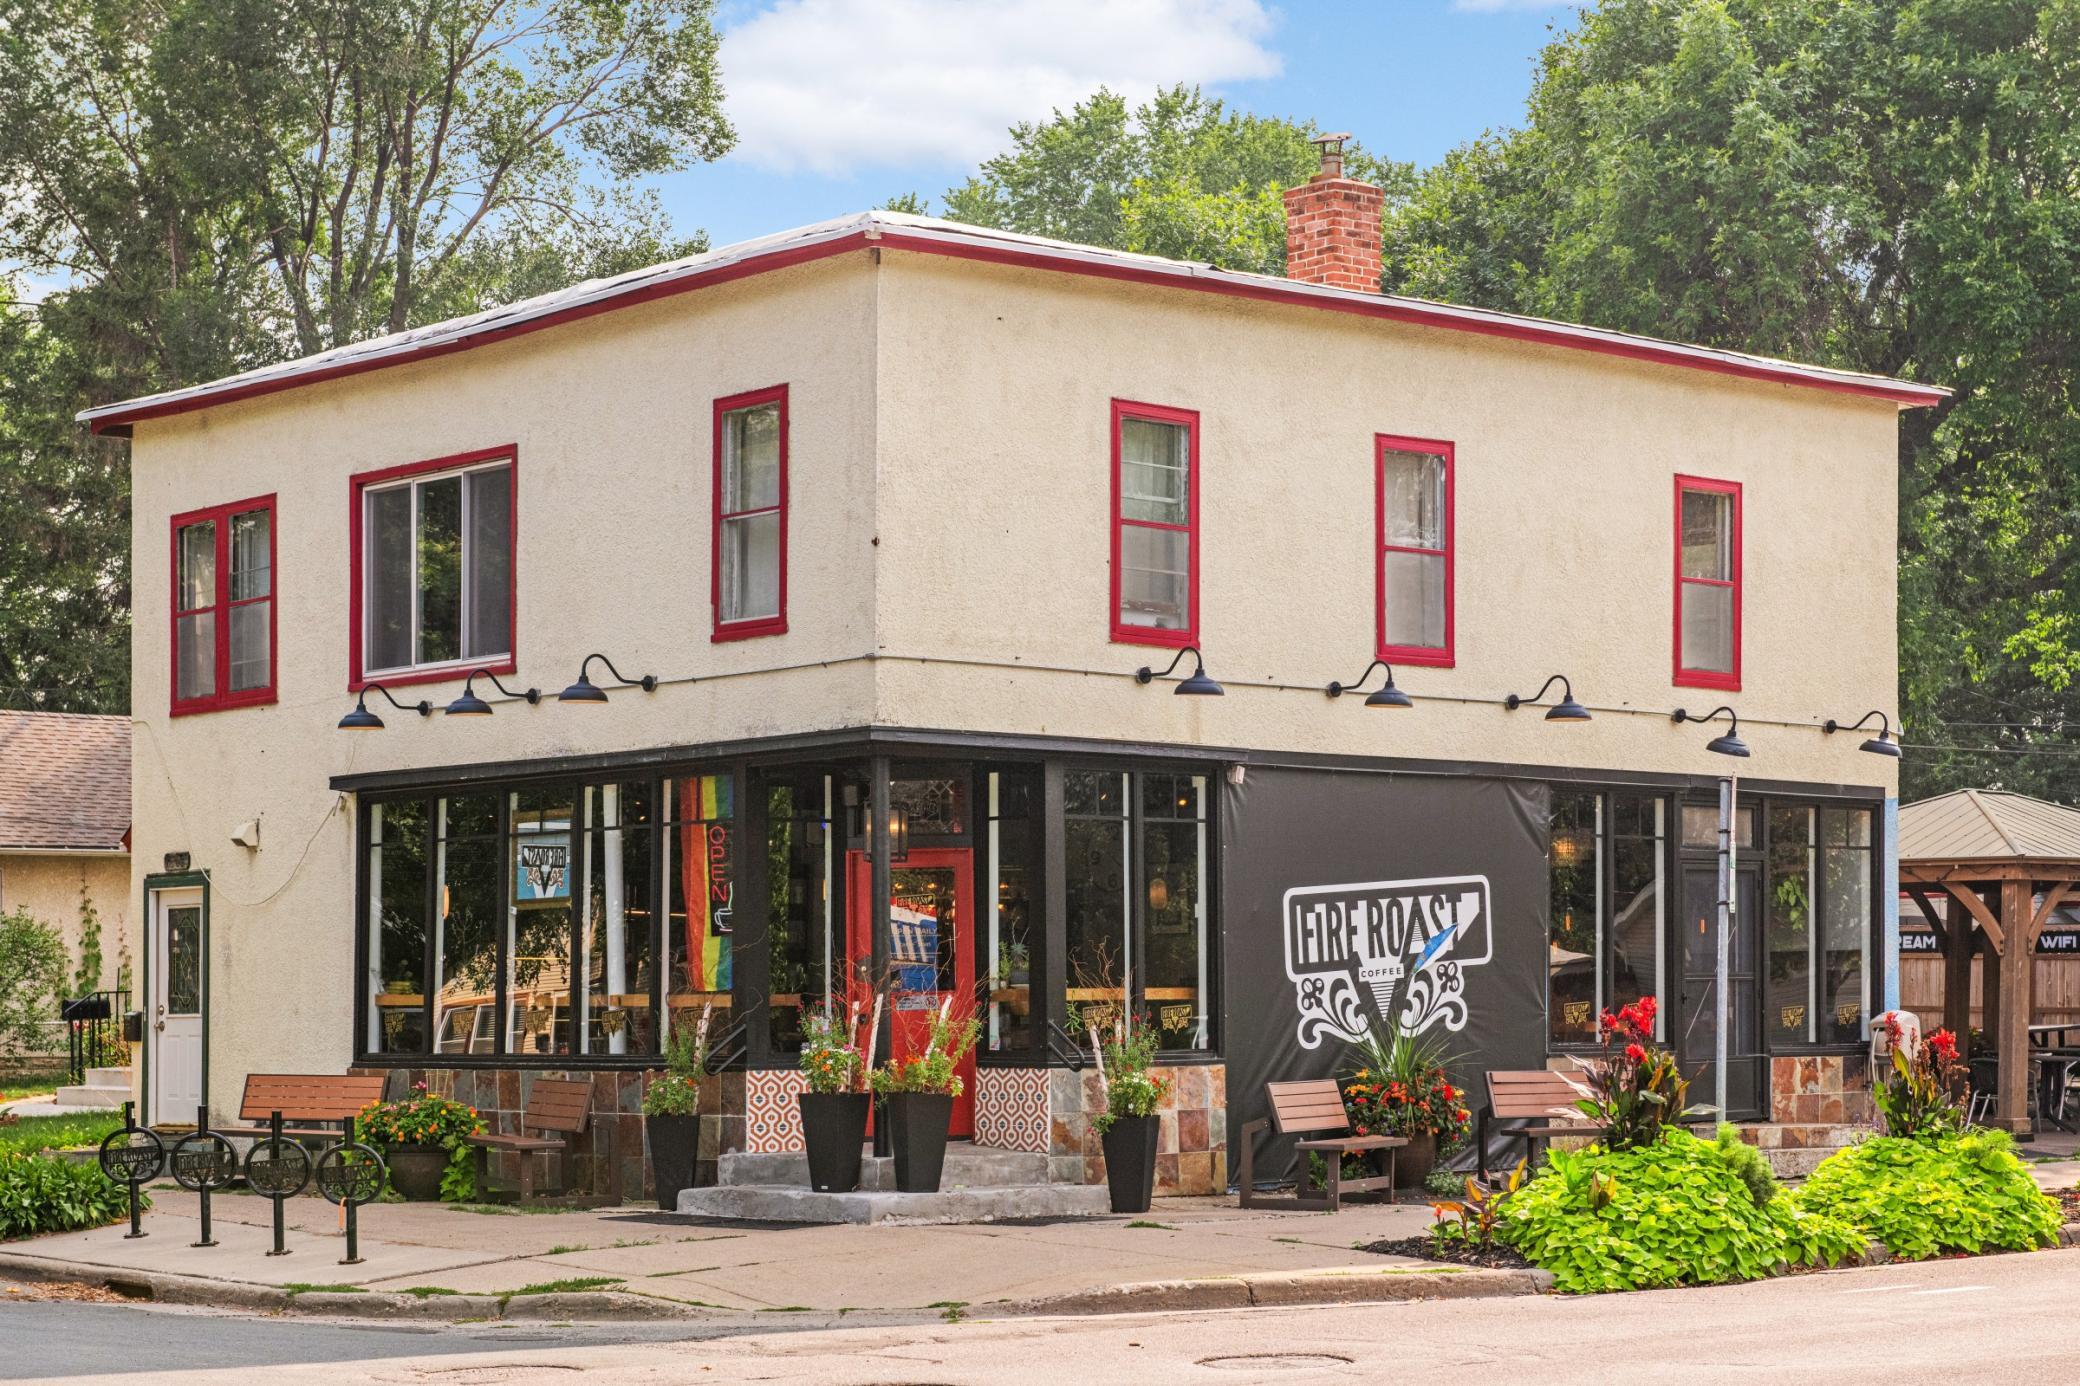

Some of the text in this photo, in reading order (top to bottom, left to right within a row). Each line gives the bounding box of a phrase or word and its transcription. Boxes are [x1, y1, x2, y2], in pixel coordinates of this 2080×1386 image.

[709, 825, 728, 901] OPEN
[2040, 935, 2077, 949] WIFI
[1361, 967, 1402, 978] COFFEE
